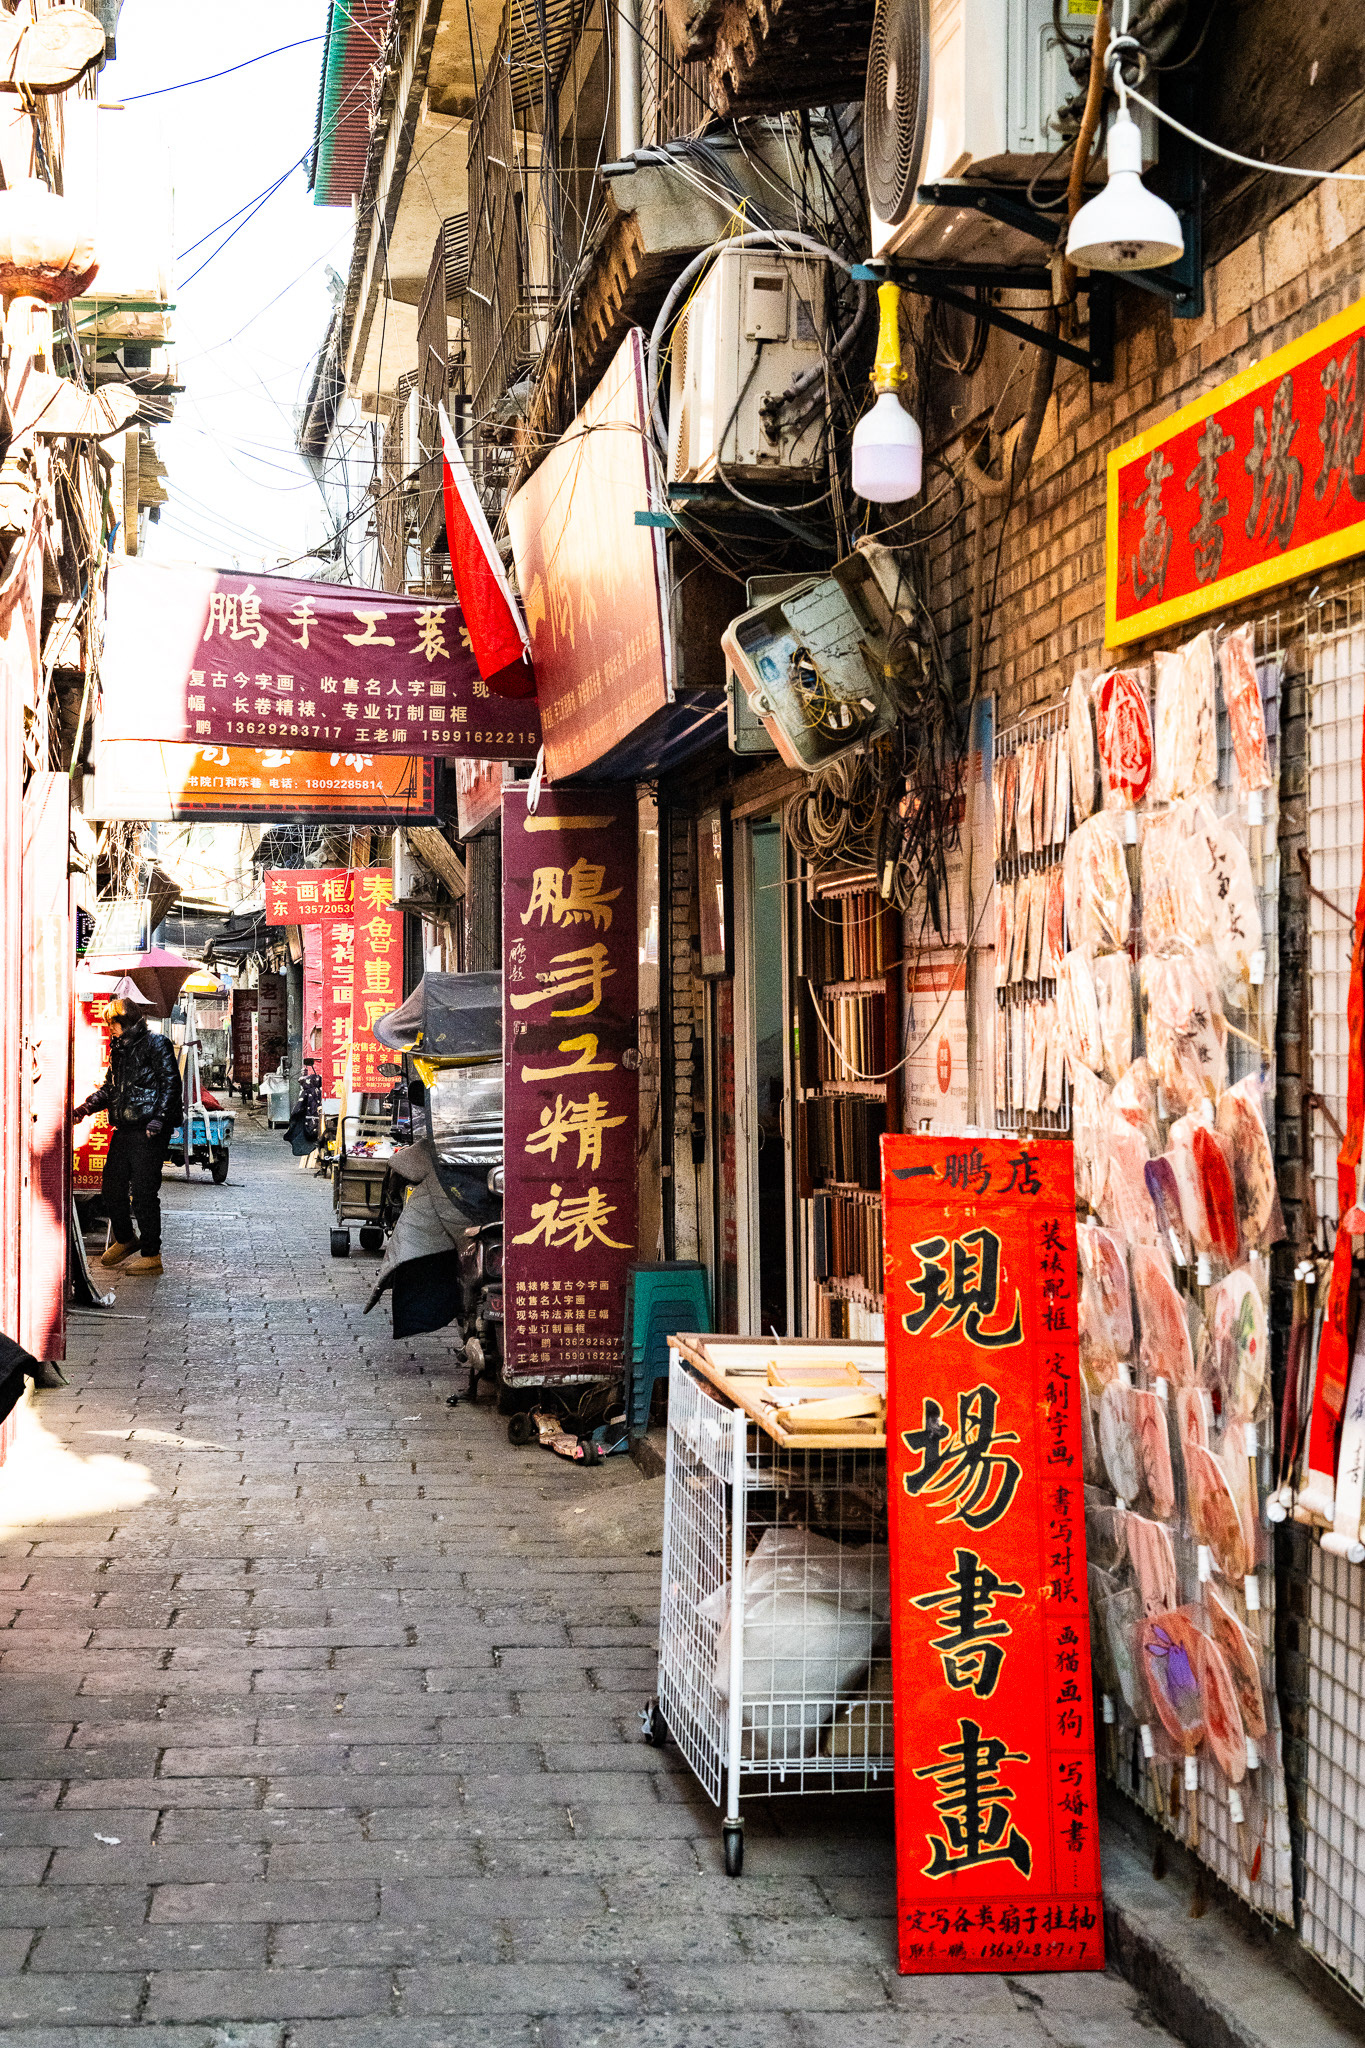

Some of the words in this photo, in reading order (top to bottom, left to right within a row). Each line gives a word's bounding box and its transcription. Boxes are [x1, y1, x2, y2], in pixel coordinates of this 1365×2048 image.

[203, 584, 475, 662] 鹏手工装
[227, 721, 341, 738] 13629283717
[355, 728, 407, 743] 王老师
[422, 730, 536, 744] 15991622215
[188, 775, 262, 788] 书院门和乐巷
[272, 880, 289, 917] 安东
[516, 1295, 586, 1306] 收售名人字画
[516, 1309, 609, 1320] 现场书法承接巨幅
[516, 1324, 586, 1335] 专业订制画框
[518, 1352, 551, 1364] 王老师
